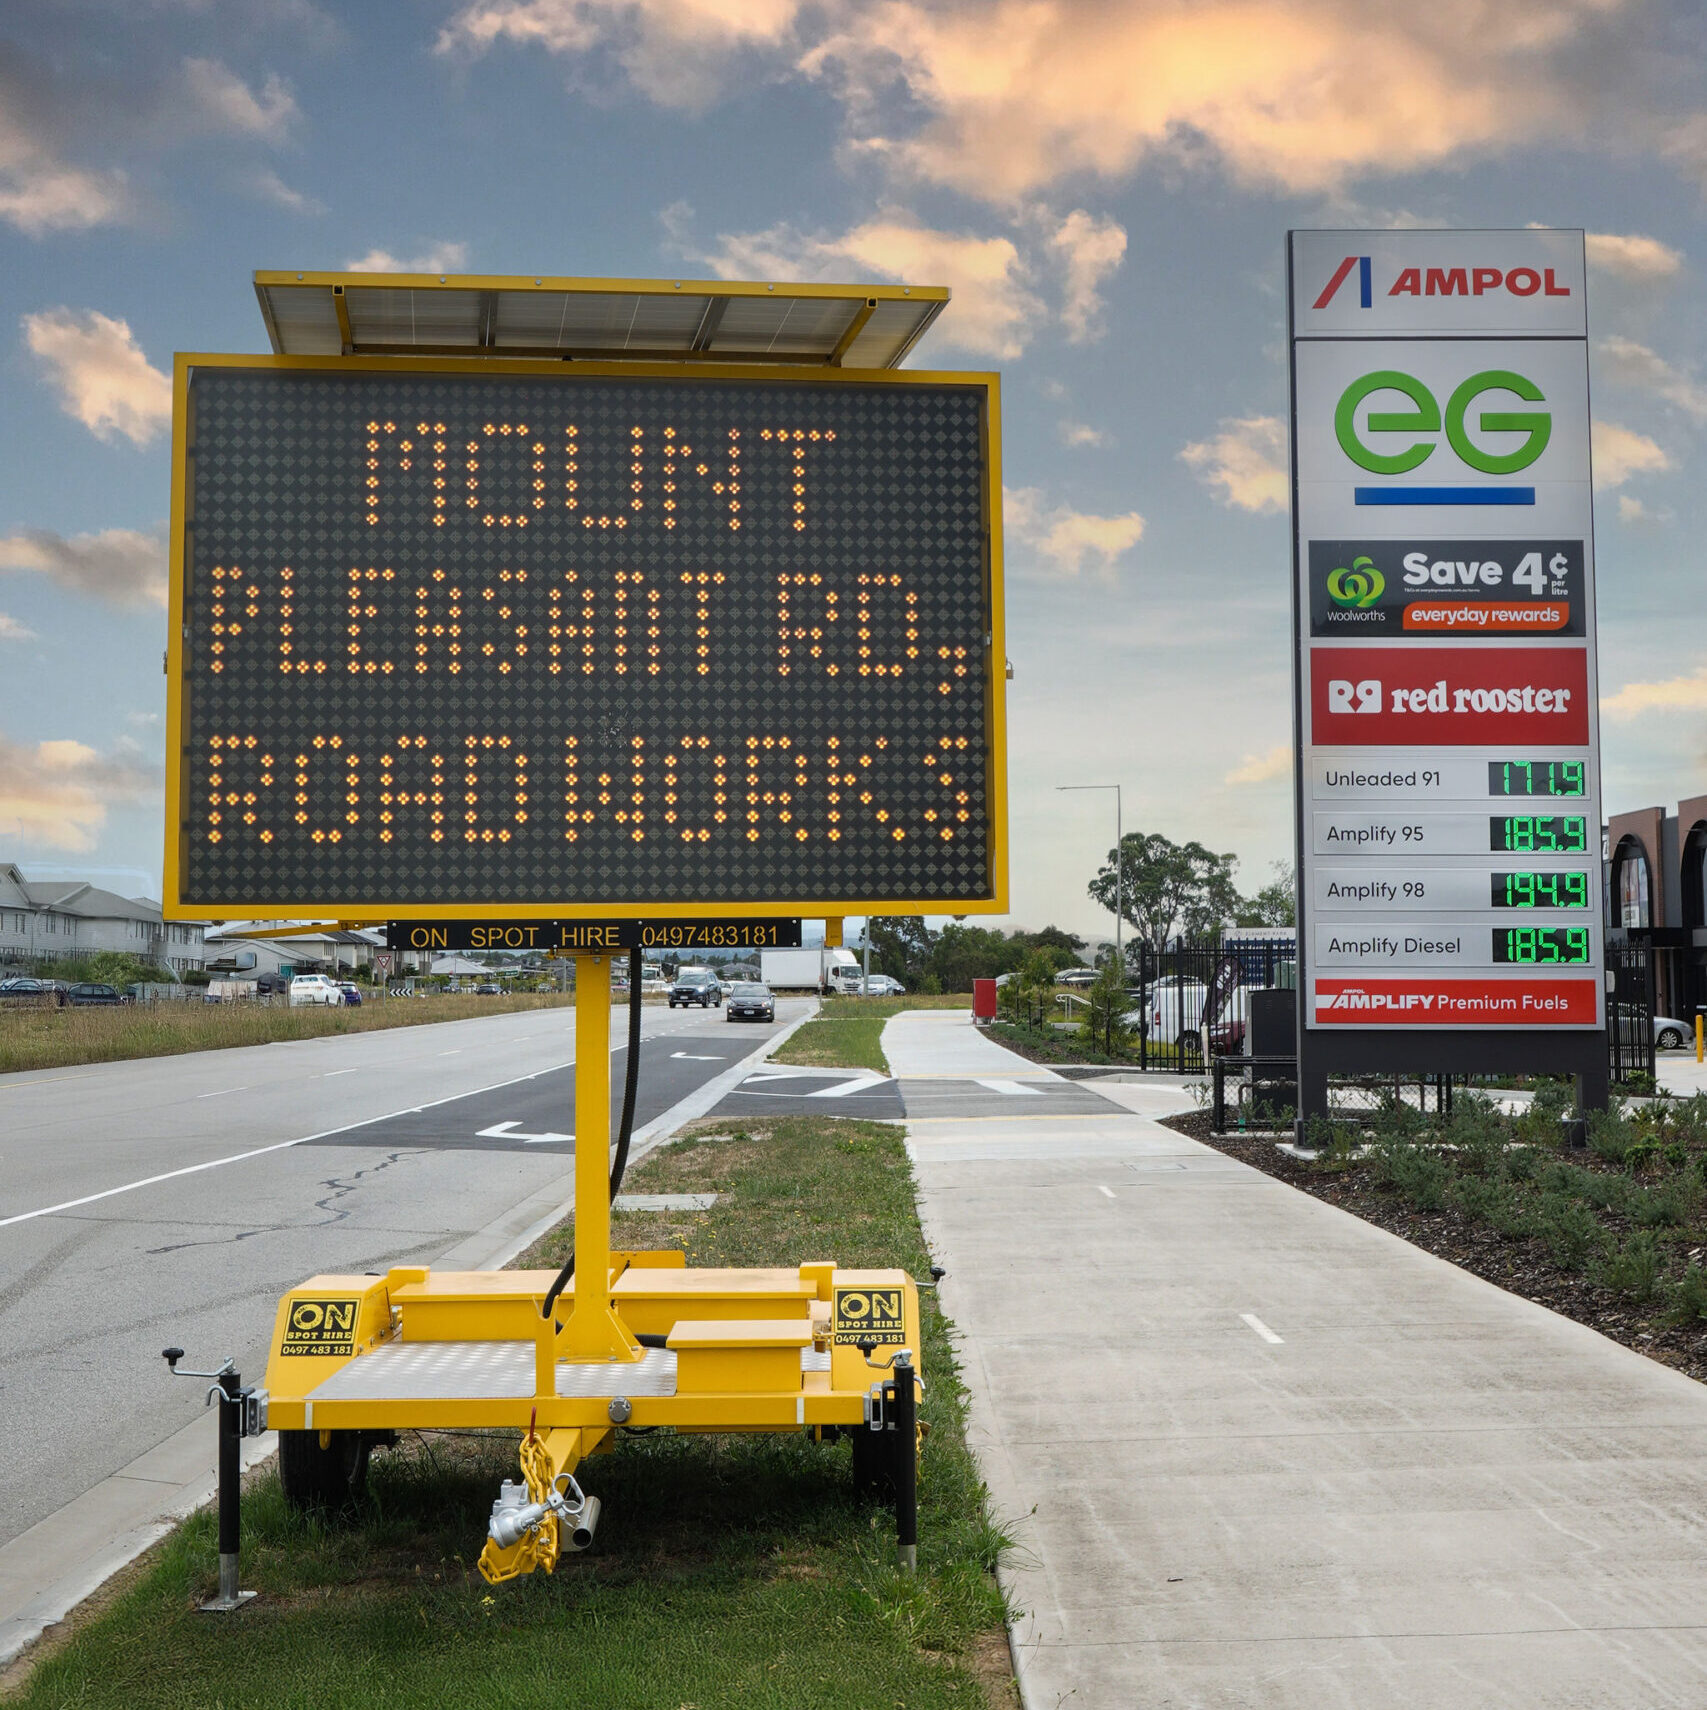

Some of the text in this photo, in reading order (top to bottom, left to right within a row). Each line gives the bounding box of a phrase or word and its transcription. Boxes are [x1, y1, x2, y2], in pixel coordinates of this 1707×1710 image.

[1388, 267, 1570, 296] AMPOL
[366, 421, 835, 531] MOUNT
[1402, 552, 1503, 585] Save
[1551, 580, 1565, 588] per
[1551, 587, 1568, 595] litre
[212, 567, 726, 675] PLEASANT
[1327, 610, 1386, 622] Woolworths
[1411, 606, 1560, 625] everyday rewards
[1391, 680, 1450, 713] red
[1453, 684, 1571, 713] rooster
[207, 735, 969, 844] ROADWORKS
[1325, 760, 1583, 796] Unleaded 91 171.9
[1326, 815, 1585, 852] Amplify 95 185.9
[1327, 871, 1586, 908] Amplify 98 194.9
[410, 925, 778, 948] ON SPOT HIRE 0497483181
[1328, 926, 1587, 963] Amplify Diesel 185.9
[1332, 994, 1569, 1010] AMPLIFY Premium Fuels
[292, 1303, 354, 1330] ON
[840, 1292, 899, 1319] ON
[287, 1331, 352, 1340] SPOT HIRE
[837, 1320, 902, 1328] SPOT HIRE
[282, 1345, 352, 1355] 0497 483 181
[835, 1334, 904, 1343] 0497 483 181
